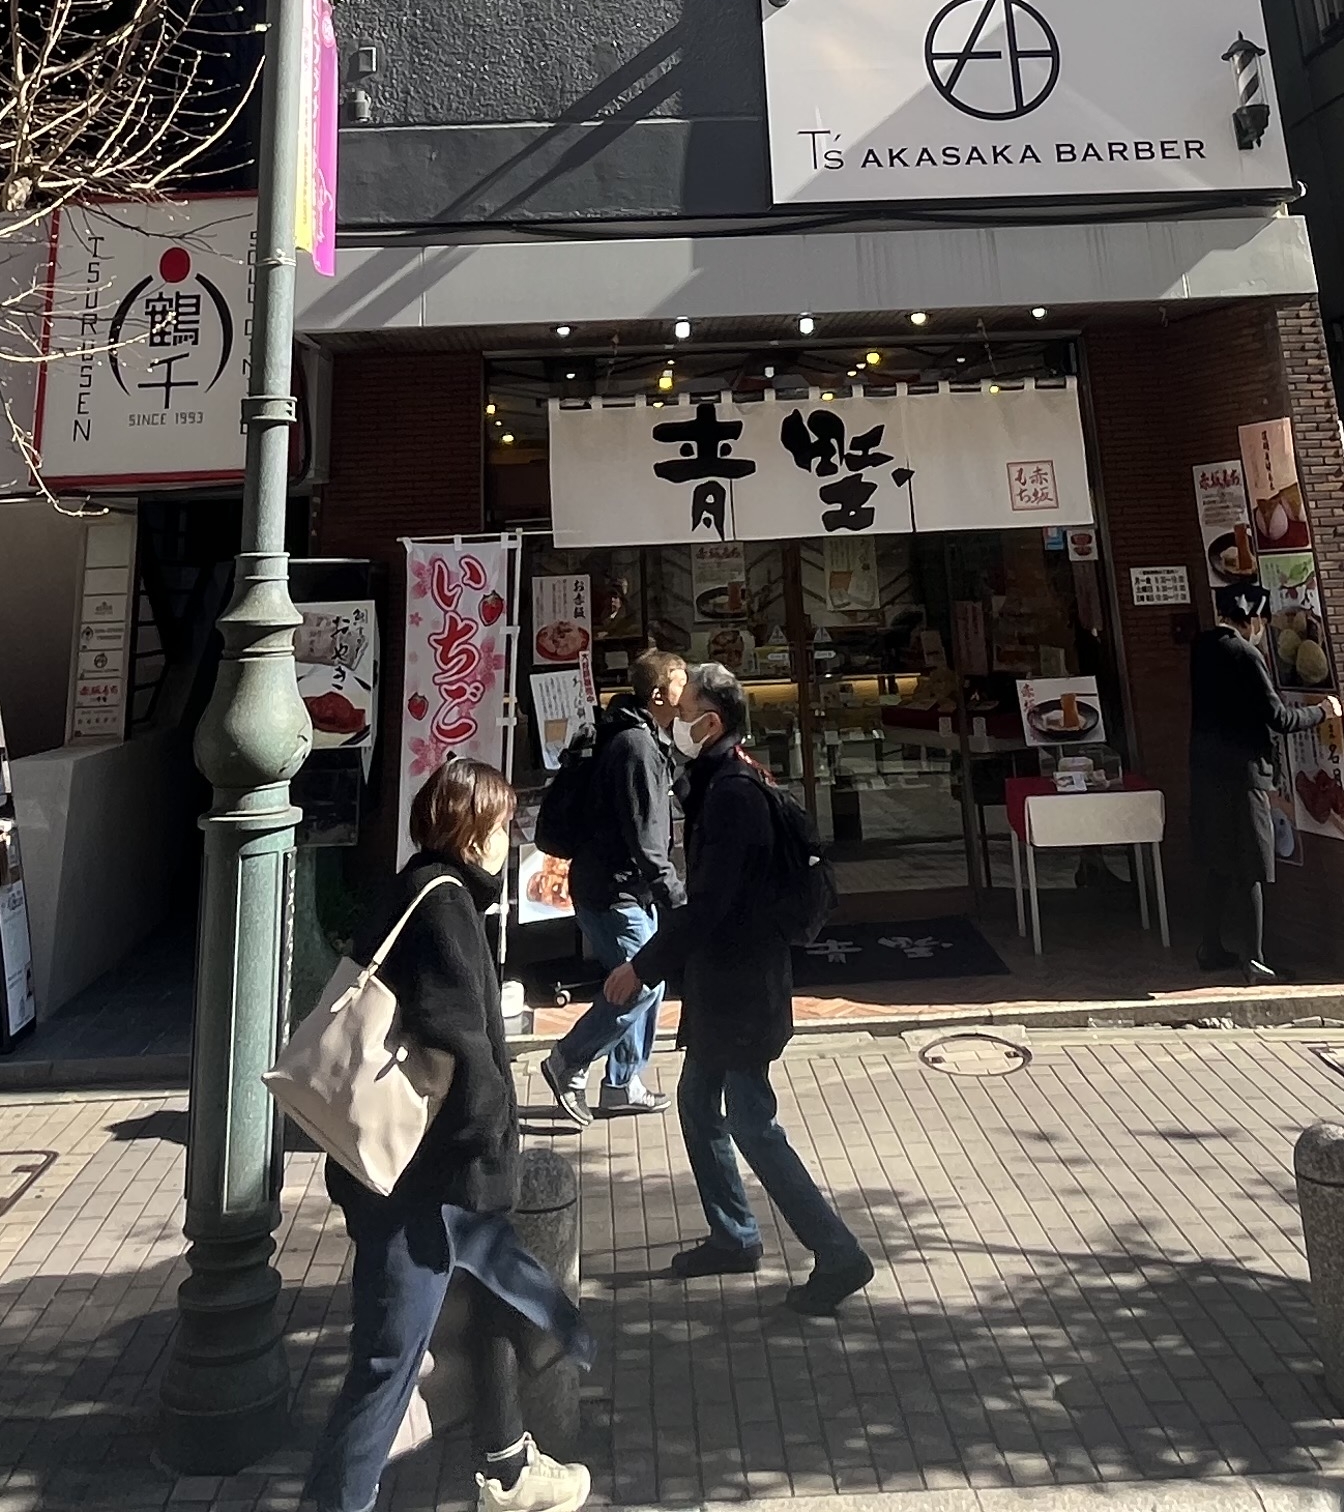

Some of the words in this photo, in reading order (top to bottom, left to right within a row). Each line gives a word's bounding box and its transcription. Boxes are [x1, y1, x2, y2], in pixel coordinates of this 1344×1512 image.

[860, 143, 1041, 169] AKASAKA
[1055, 139, 1207, 164] BARBER
[137, 290, 202, 410] 鶴千
[128, 412, 168, 427] SINCE
[174, 411, 205, 425] 1993
[1028, 465, 1054, 505] 赤坂
[330, 615, 351, 690] おやき
[428, 554, 488, 744] いちご
